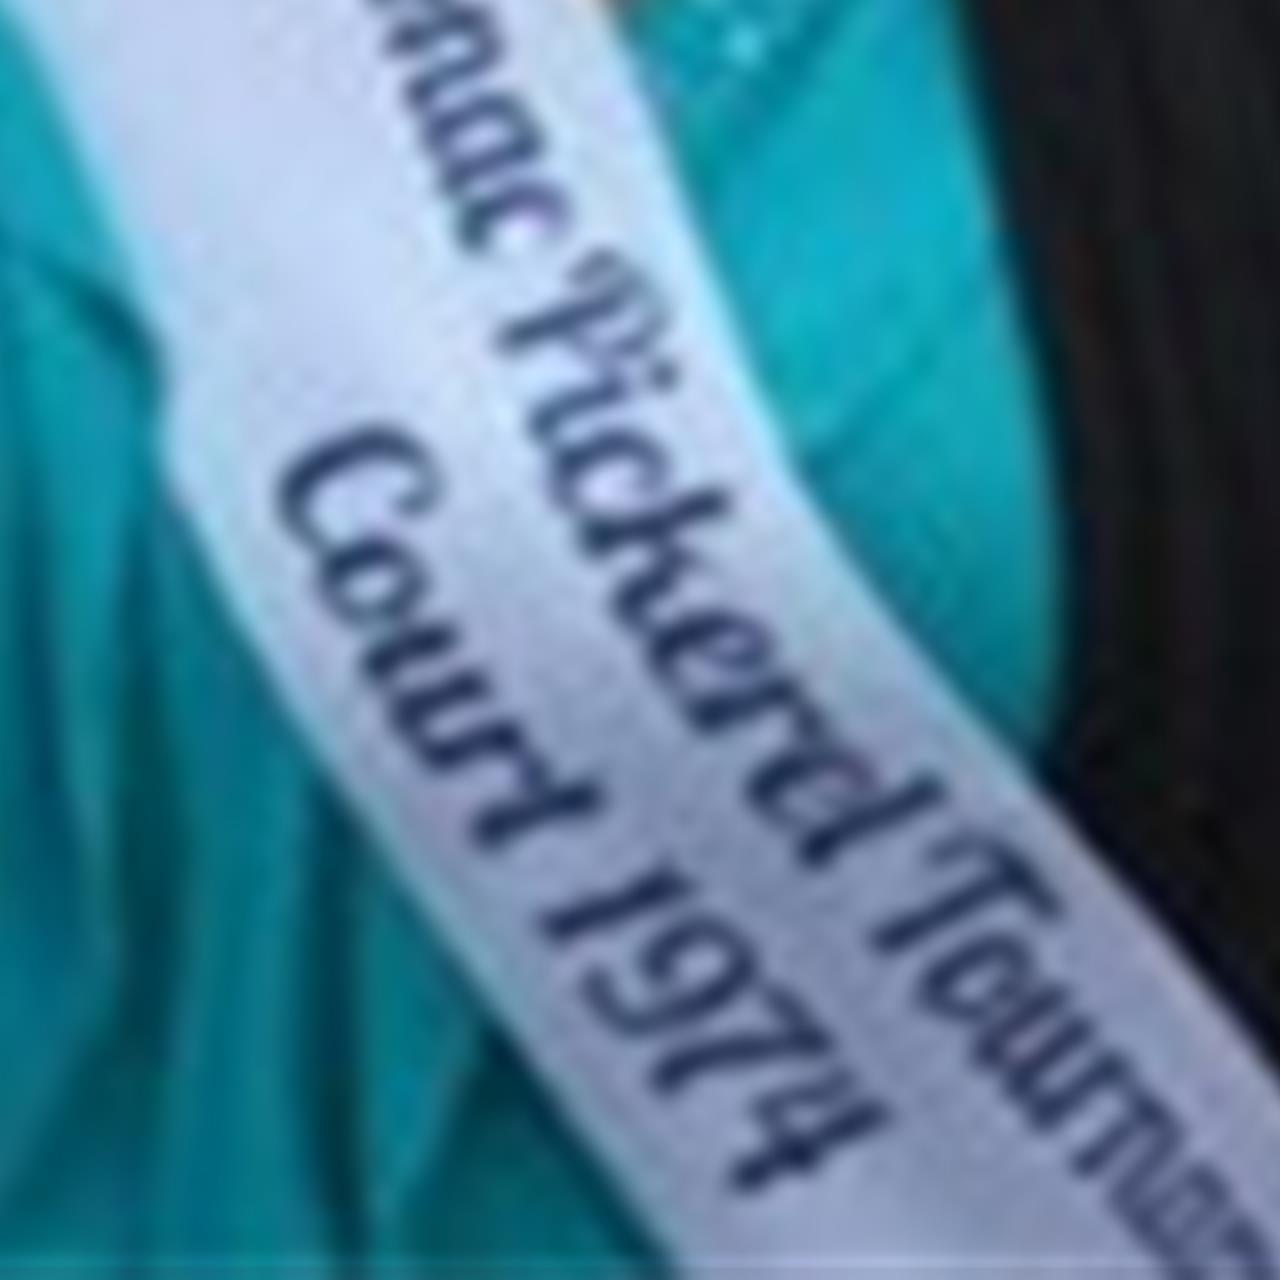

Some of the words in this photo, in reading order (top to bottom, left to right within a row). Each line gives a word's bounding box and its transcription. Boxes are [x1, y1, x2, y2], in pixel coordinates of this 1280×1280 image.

[274, 422, 606, 850] Court
[538, 856, 898, 1198] 1974
[492, 246, 950, 870] Pickerel
